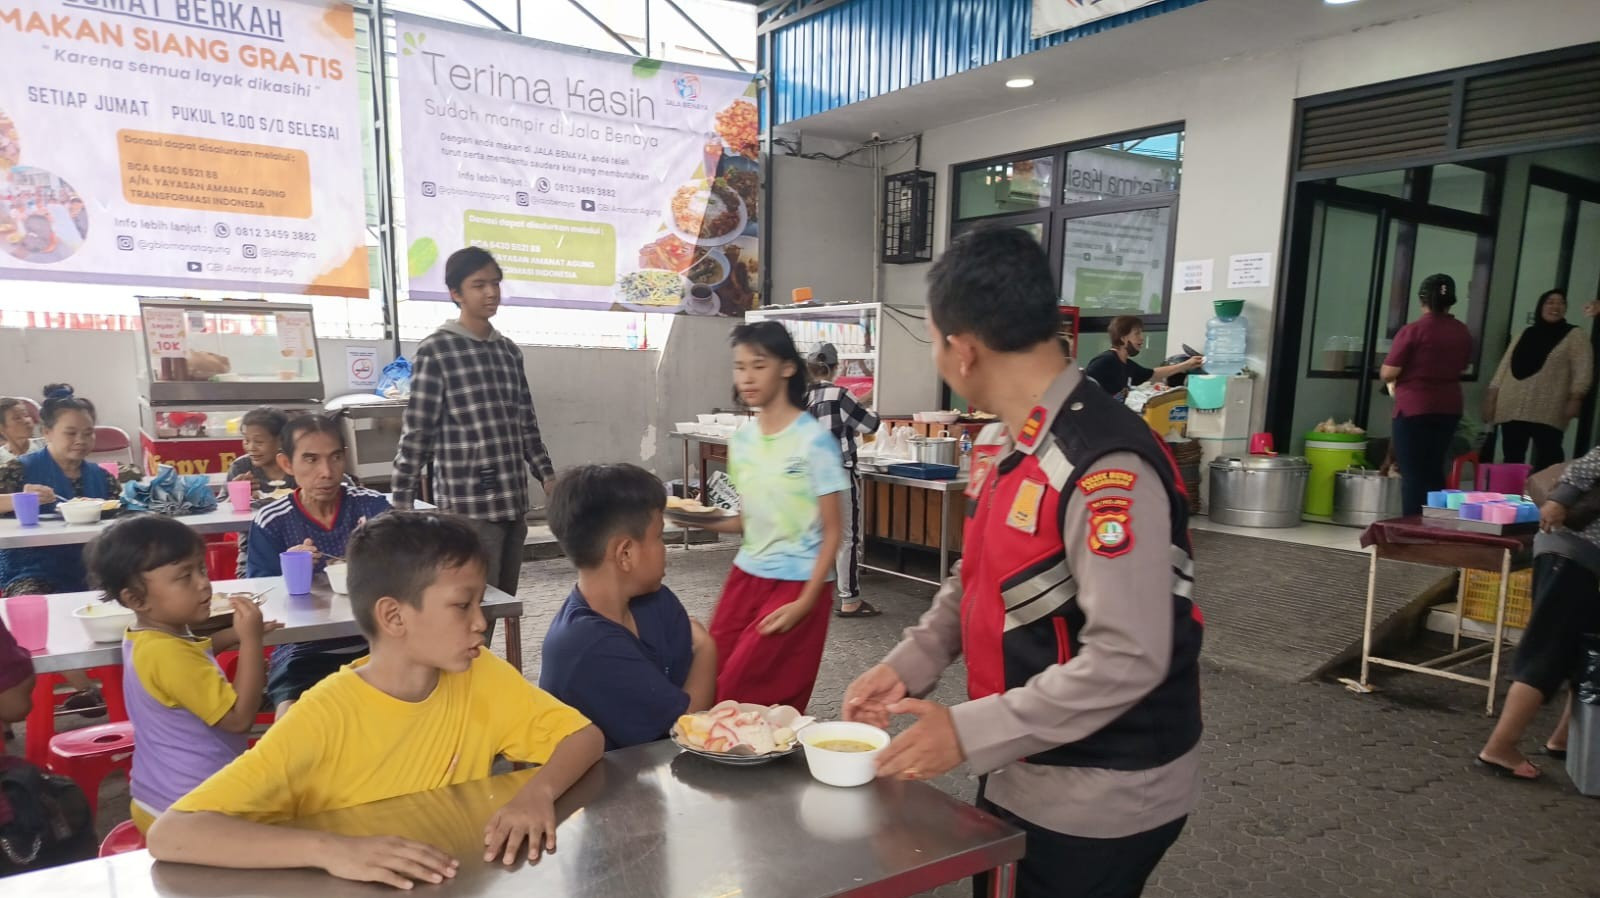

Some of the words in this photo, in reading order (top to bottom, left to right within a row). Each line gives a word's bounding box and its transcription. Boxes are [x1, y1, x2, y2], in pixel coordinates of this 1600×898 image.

[175, 0, 284, 38] BERKAH
[0, 8, 124, 47] MAKAN
[132, 27, 230, 64] SIANG
[239, 44, 344, 81] GRATIS
[128, 60, 192, 80] semua
[195, 68, 244, 88] layak
[422, 50, 553, 105] Terima
[565, 76, 656, 121] Kasih
[27, 86, 88, 109] SETIAP
[94, 94, 149, 117] JUMAT
[171, 105, 217, 126] PUKUL
[220, 111, 256, 130] 12.00
[287, 121, 340, 141] SELESAI
[424, 97, 480, 122] Sudah
[484, 110, 546, 134] mampir
[550, 119, 564, 137] di
[567, 121, 601, 140] Jala
[604, 125, 659, 151] Benaya
[123, 134, 163, 148] Donasi
[164, 138, 196, 152] dapat
[198, 142, 253, 158] disalurkan
[127, 162, 150, 173] BCA
[129, 188, 212, 206] TRANSFORMASI
[212, 197, 265, 210] INDONESIA
[154, 178, 206, 192] YAYASAN
[206, 182, 250, 196] AMANAT
[252, 187, 288, 199] AGUNG
[114, 217, 138, 229] Info
[235, 226, 261, 238] 0812
[264, 228, 290, 240] 3459
[156, 340, 181, 351] 10K
